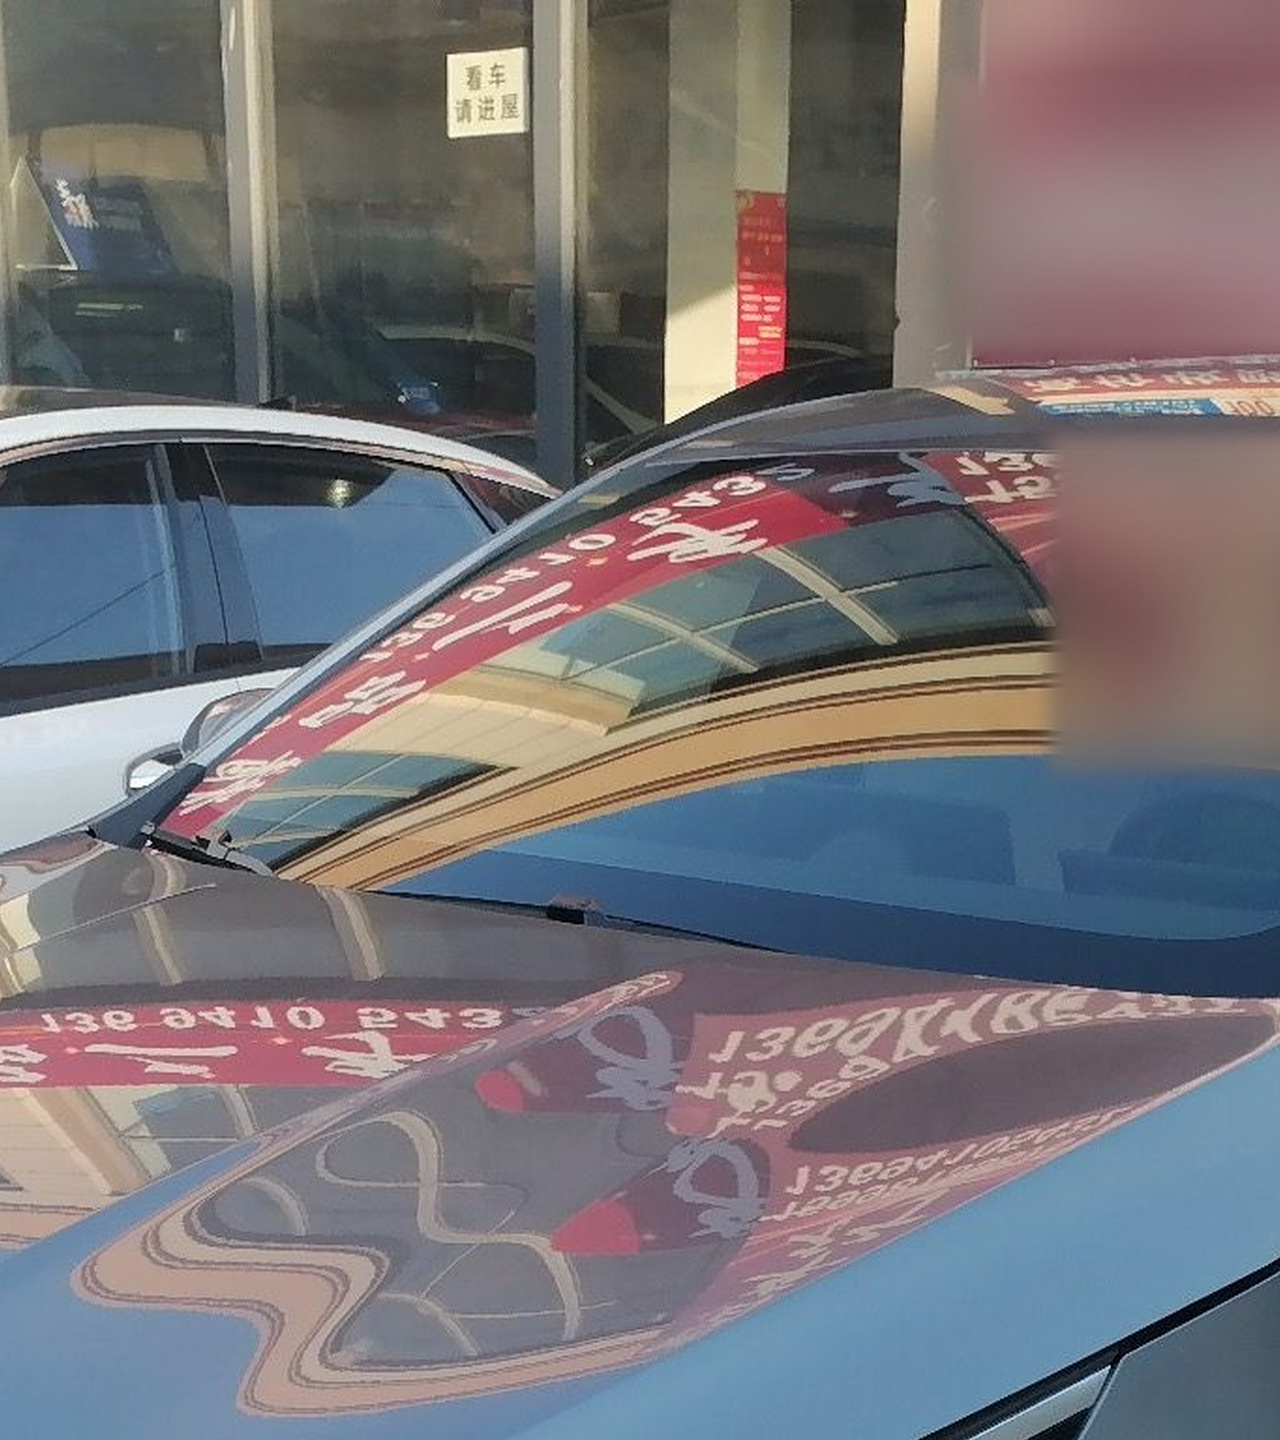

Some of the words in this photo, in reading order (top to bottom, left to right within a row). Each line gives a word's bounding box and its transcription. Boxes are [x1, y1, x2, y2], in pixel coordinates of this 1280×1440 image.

[465, 63, 505, 90] 看车
[455, 93, 520, 122] 请进屋
